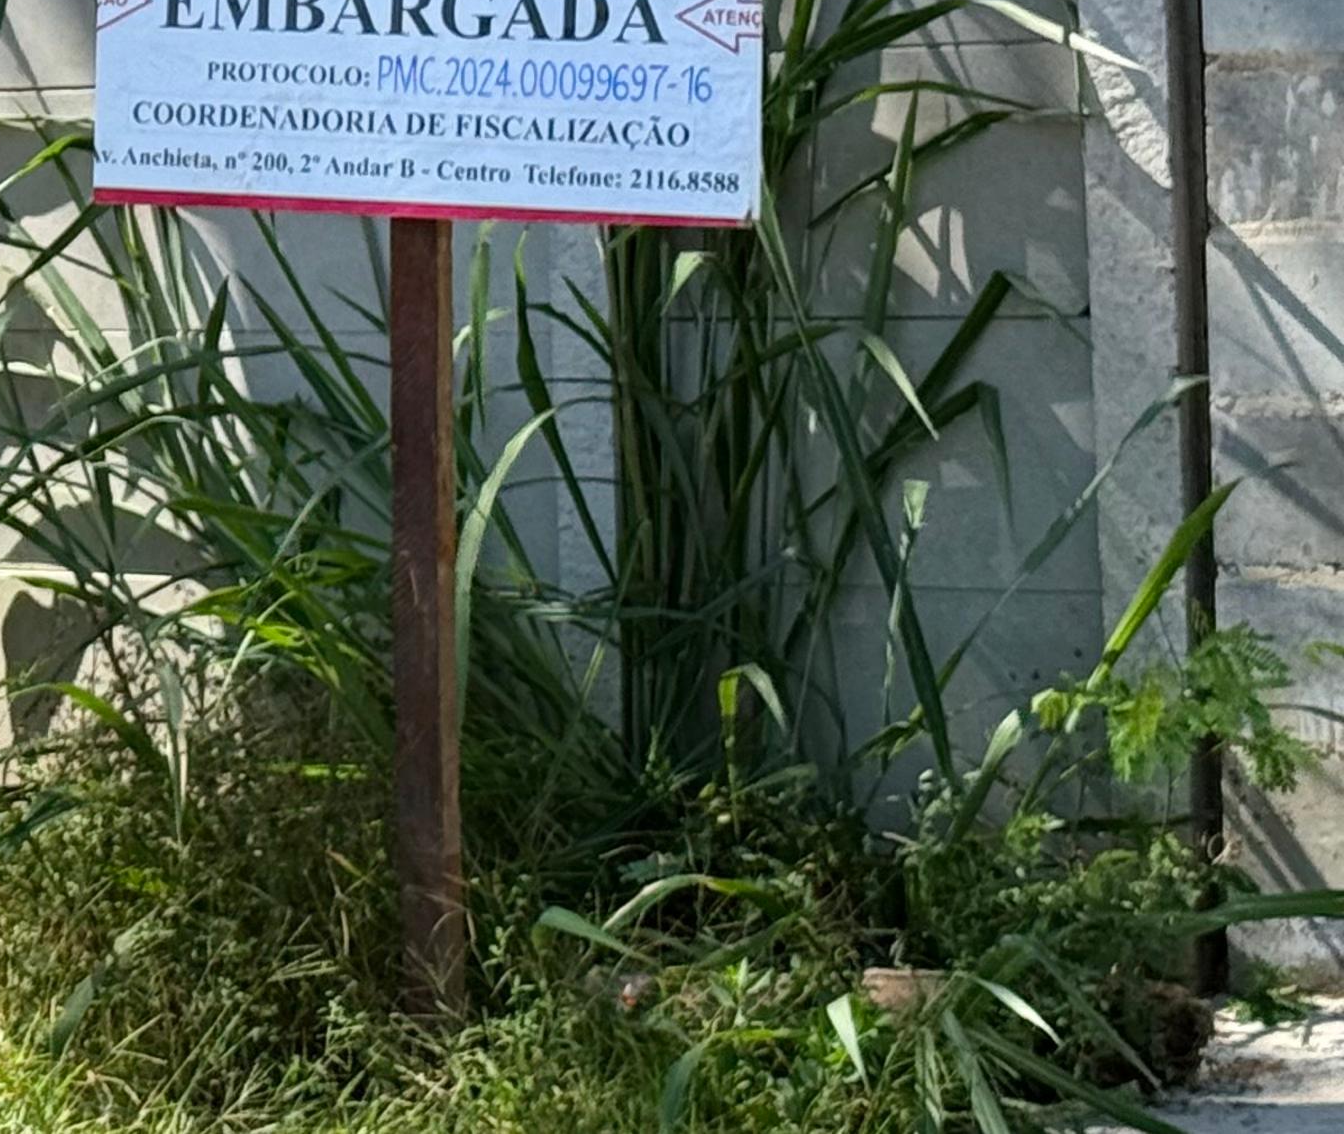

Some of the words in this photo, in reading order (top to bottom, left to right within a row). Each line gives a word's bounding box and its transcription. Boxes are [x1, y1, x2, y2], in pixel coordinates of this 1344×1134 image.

[207, 61, 371, 87] PROTOCOLO:
[377, 54, 713, 104] PMC.2024.00099697-16
[132, 100, 398, 136] COORDENADORIA
[405, 113, 447, 137] DE
[454, 114, 691, 151] FISCALIZAÇÃO
[121, 147, 219, 172] Anchieta,
[251, 151, 295, 175] 200,
[324, 155, 395, 177] Andar
[399, 158, 416, 179] B
[436, 159, 512, 184] Centro
[523, 163, 623, 189] Telefone:
[628, 168, 740, 194] 2116.8588
